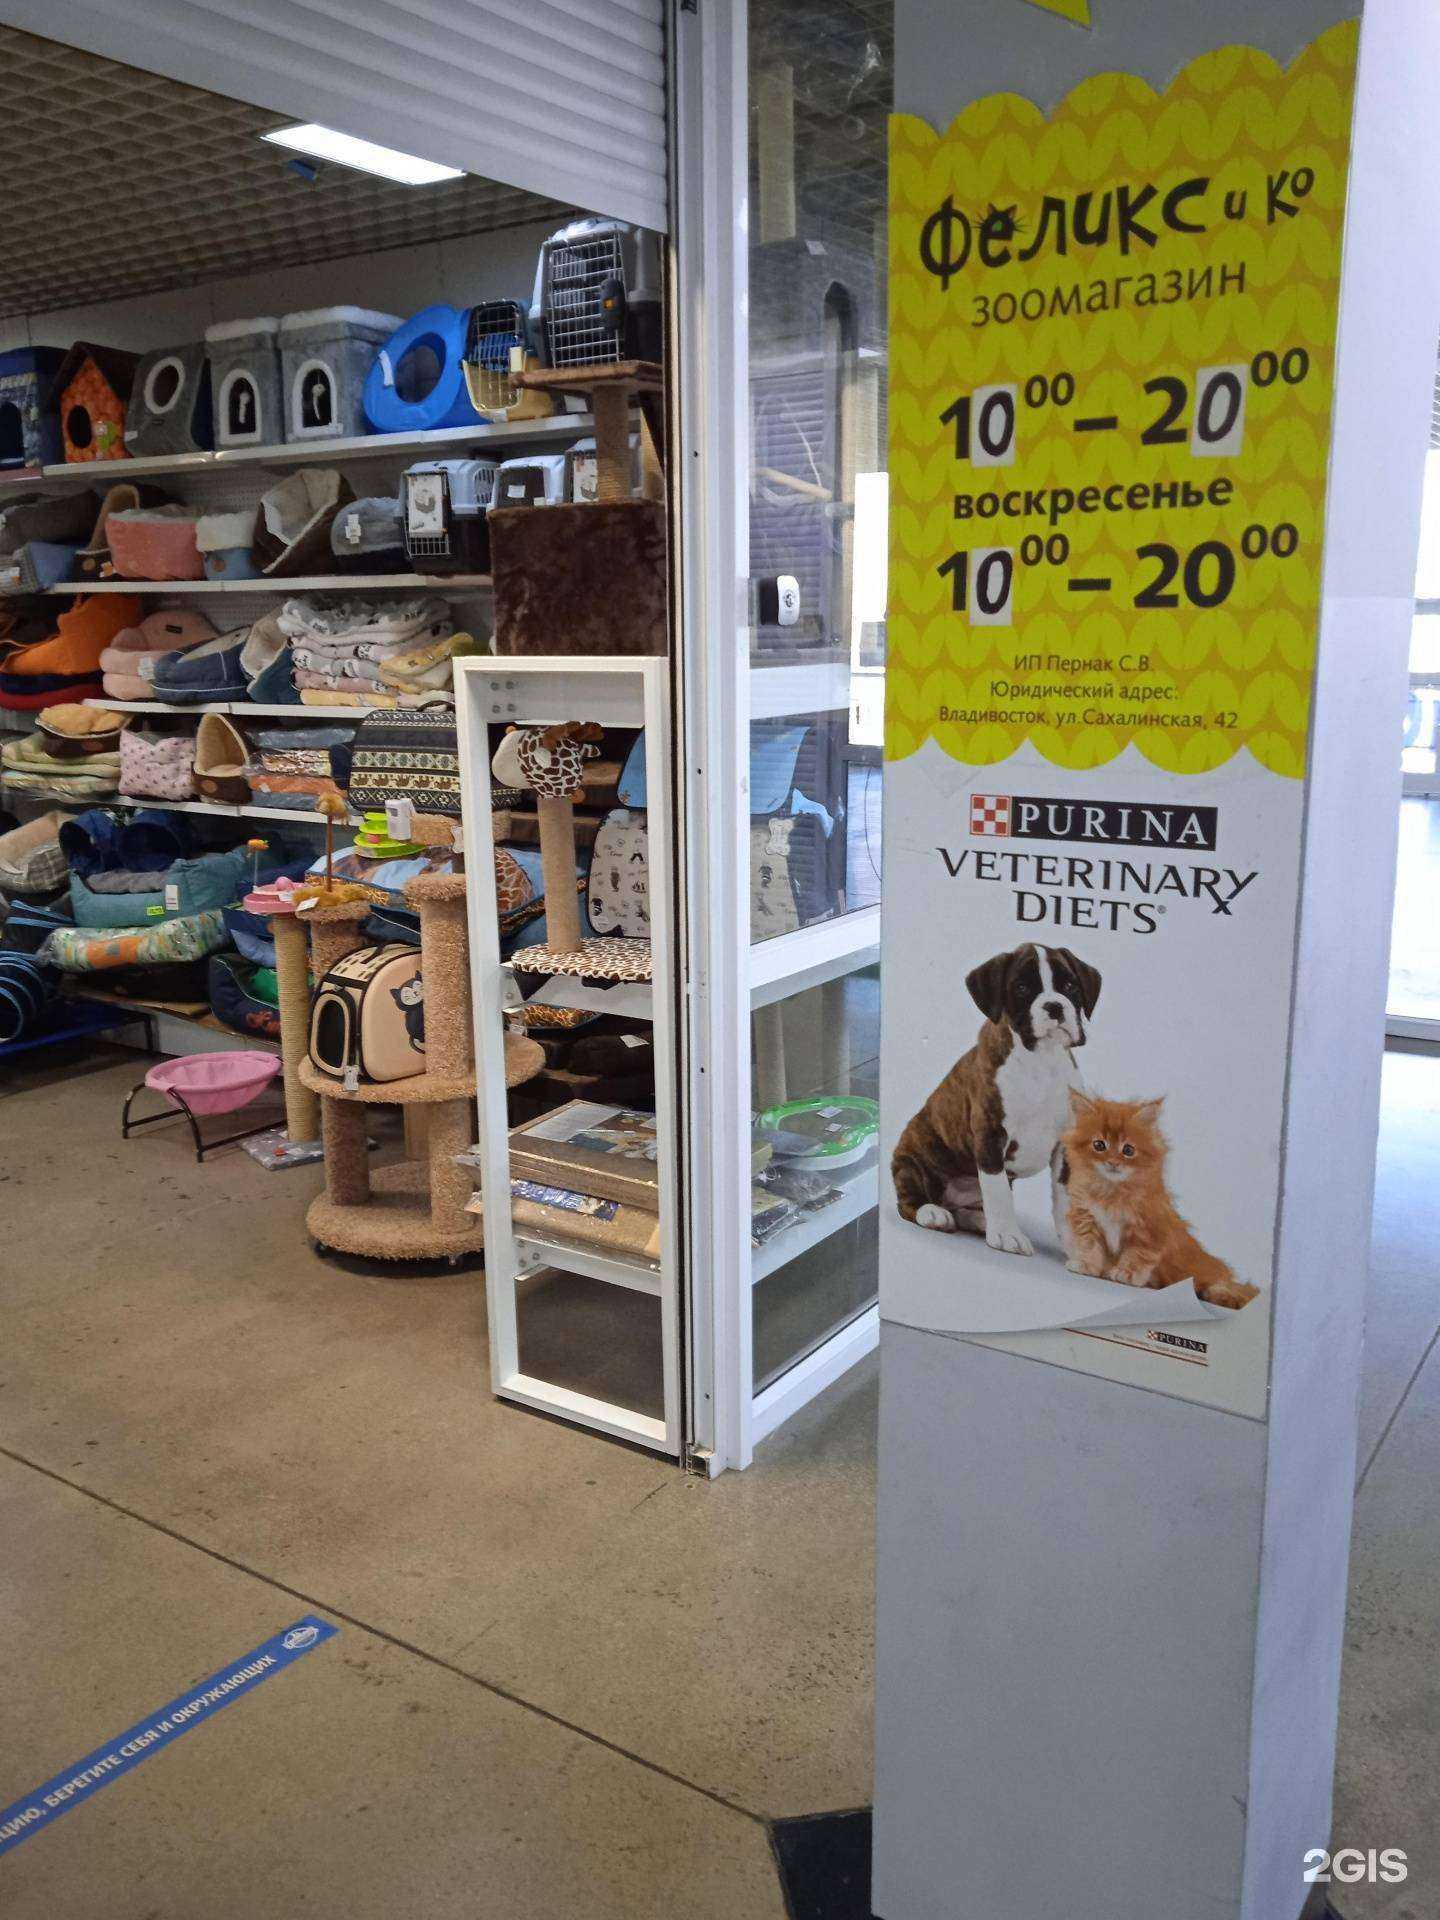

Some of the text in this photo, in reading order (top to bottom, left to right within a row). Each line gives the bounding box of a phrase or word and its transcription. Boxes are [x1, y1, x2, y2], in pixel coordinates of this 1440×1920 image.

[971, 262, 1246, 327] зоомагазин
[953, 477, 1235, 526] воскресенье
[1014, 655, 1042, 670] ИП
[1047, 655, 1113, 675] Пернак
[990, 681, 1178, 702] Юридический адрес:
[939, 706, 1050, 725] Владивосток,
[1214, 712, 1239, 729] 42
[1018, 804, 1208, 846] PURINA
[936, 847, 1259, 916] VETERINARY
[1159, 1333, 1207, 1352] PURINA
[0, 1654, 277, 1843] ЦИЮ, БЕРЕГИТЕ СЕБЯ И ОКРУЖАЮЩИХ
